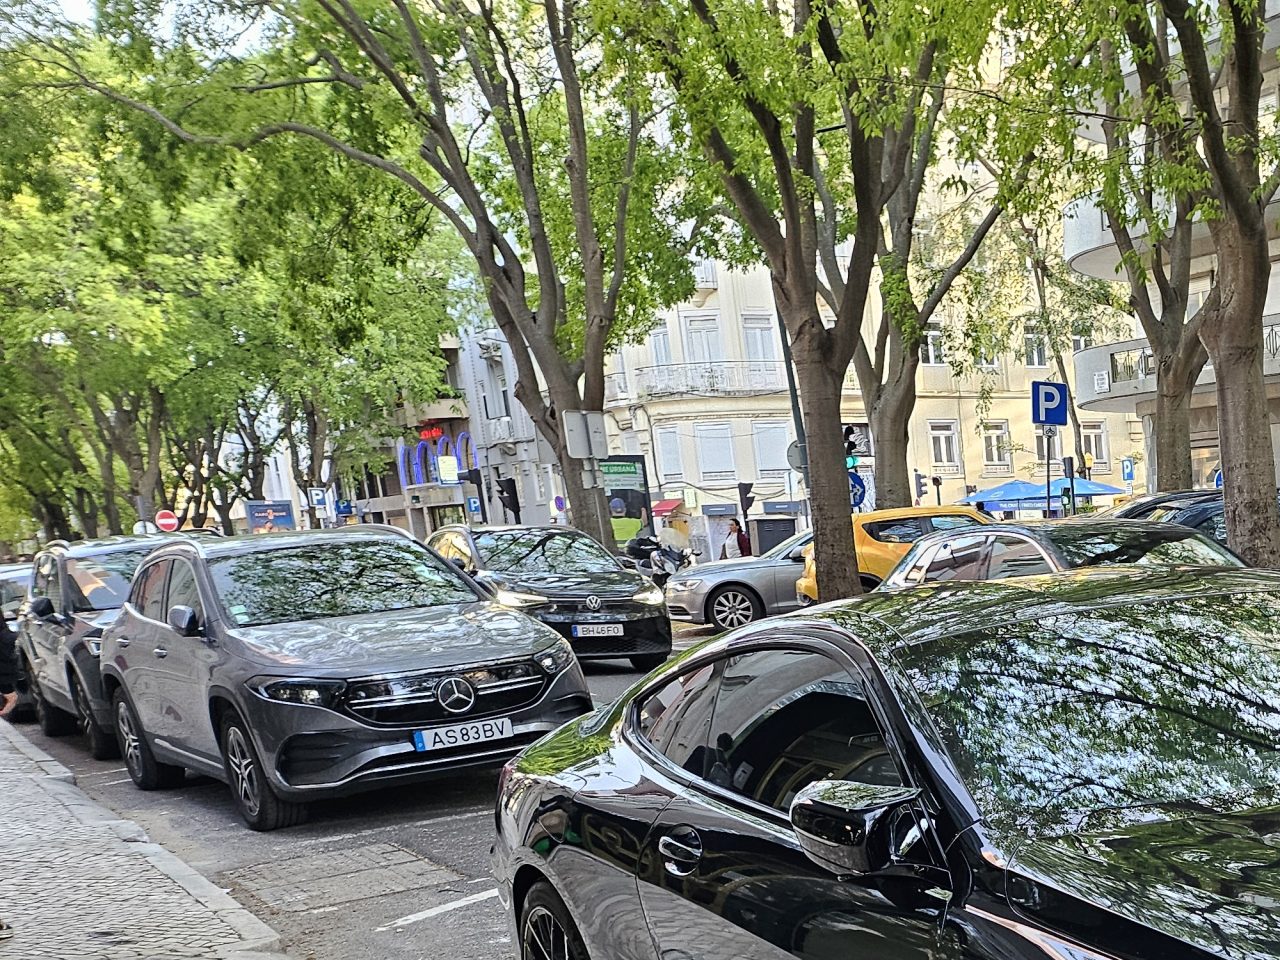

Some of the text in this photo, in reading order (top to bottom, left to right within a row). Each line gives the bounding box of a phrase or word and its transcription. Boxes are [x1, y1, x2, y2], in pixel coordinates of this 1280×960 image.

[1039, 384, 1061, 421] P
[1123, 460, 1132, 480] P
[311, 489, 324, 504] P
[470, 498, 480, 511] P
[432, 720, 505, 747] AS83BV
